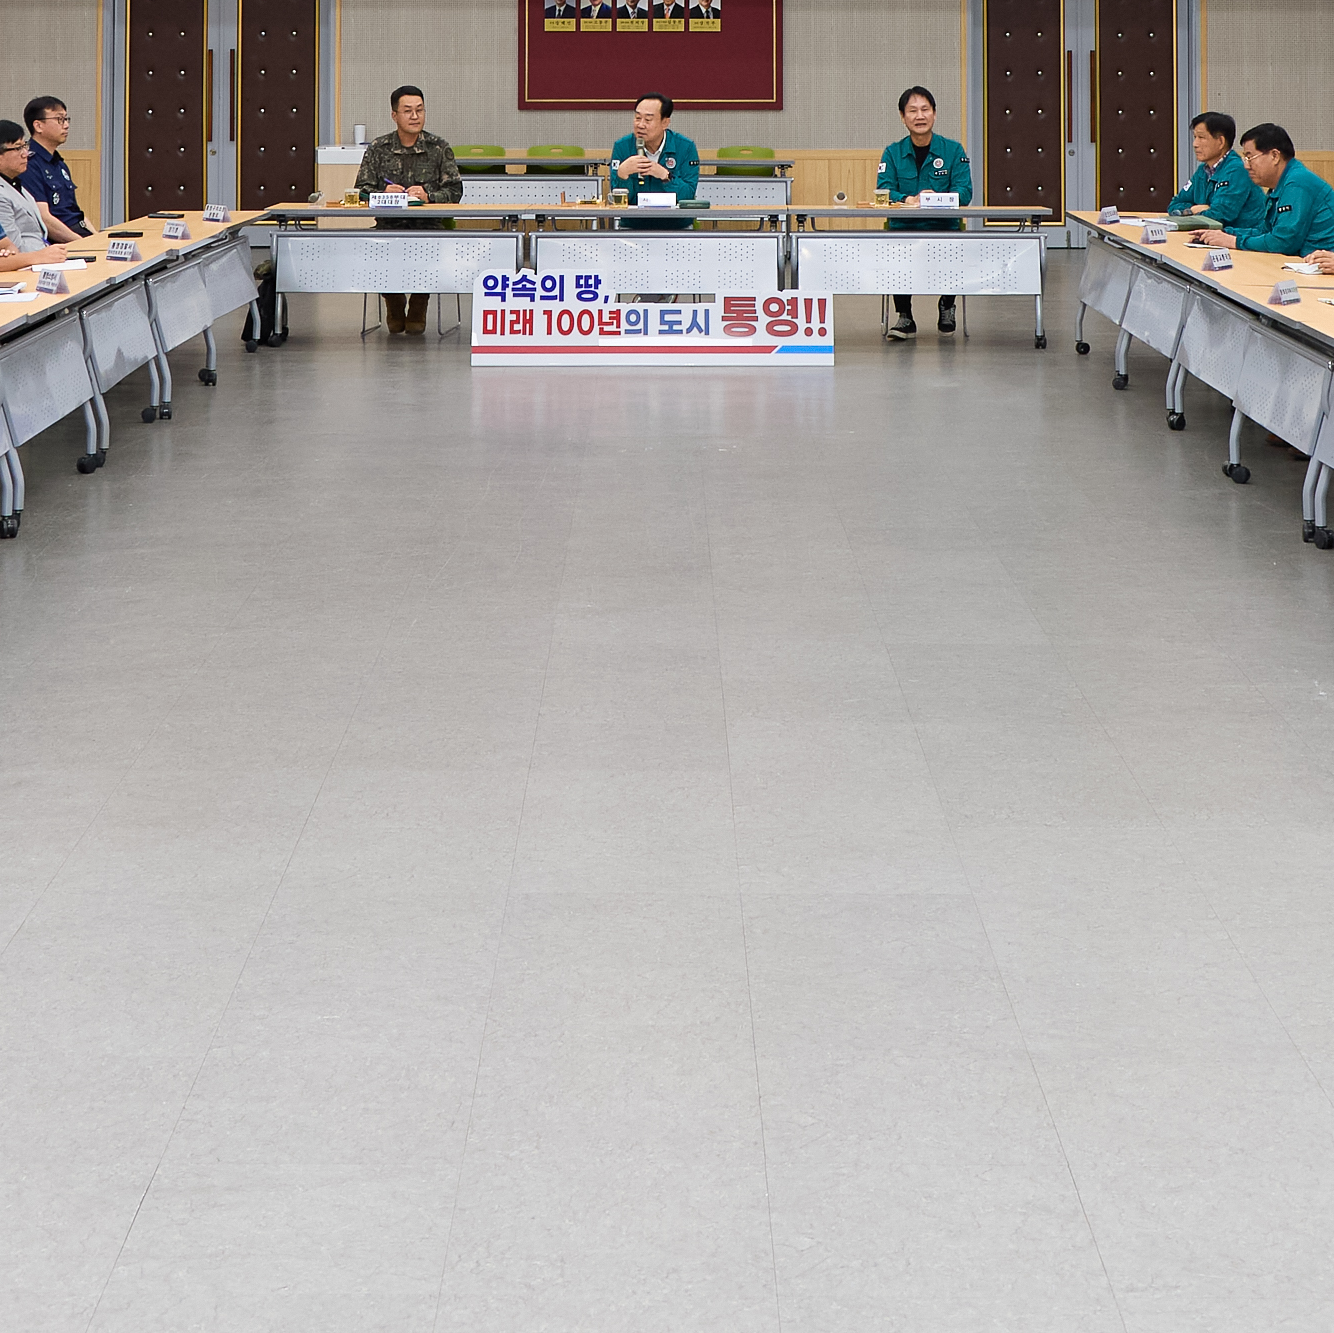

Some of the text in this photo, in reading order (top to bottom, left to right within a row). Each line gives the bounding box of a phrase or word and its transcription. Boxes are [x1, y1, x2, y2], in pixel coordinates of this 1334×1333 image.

[482, 274, 610, 304] 약속의 땅,
[482, 296, 827, 338] 미래 100년의 도시 통영!!
